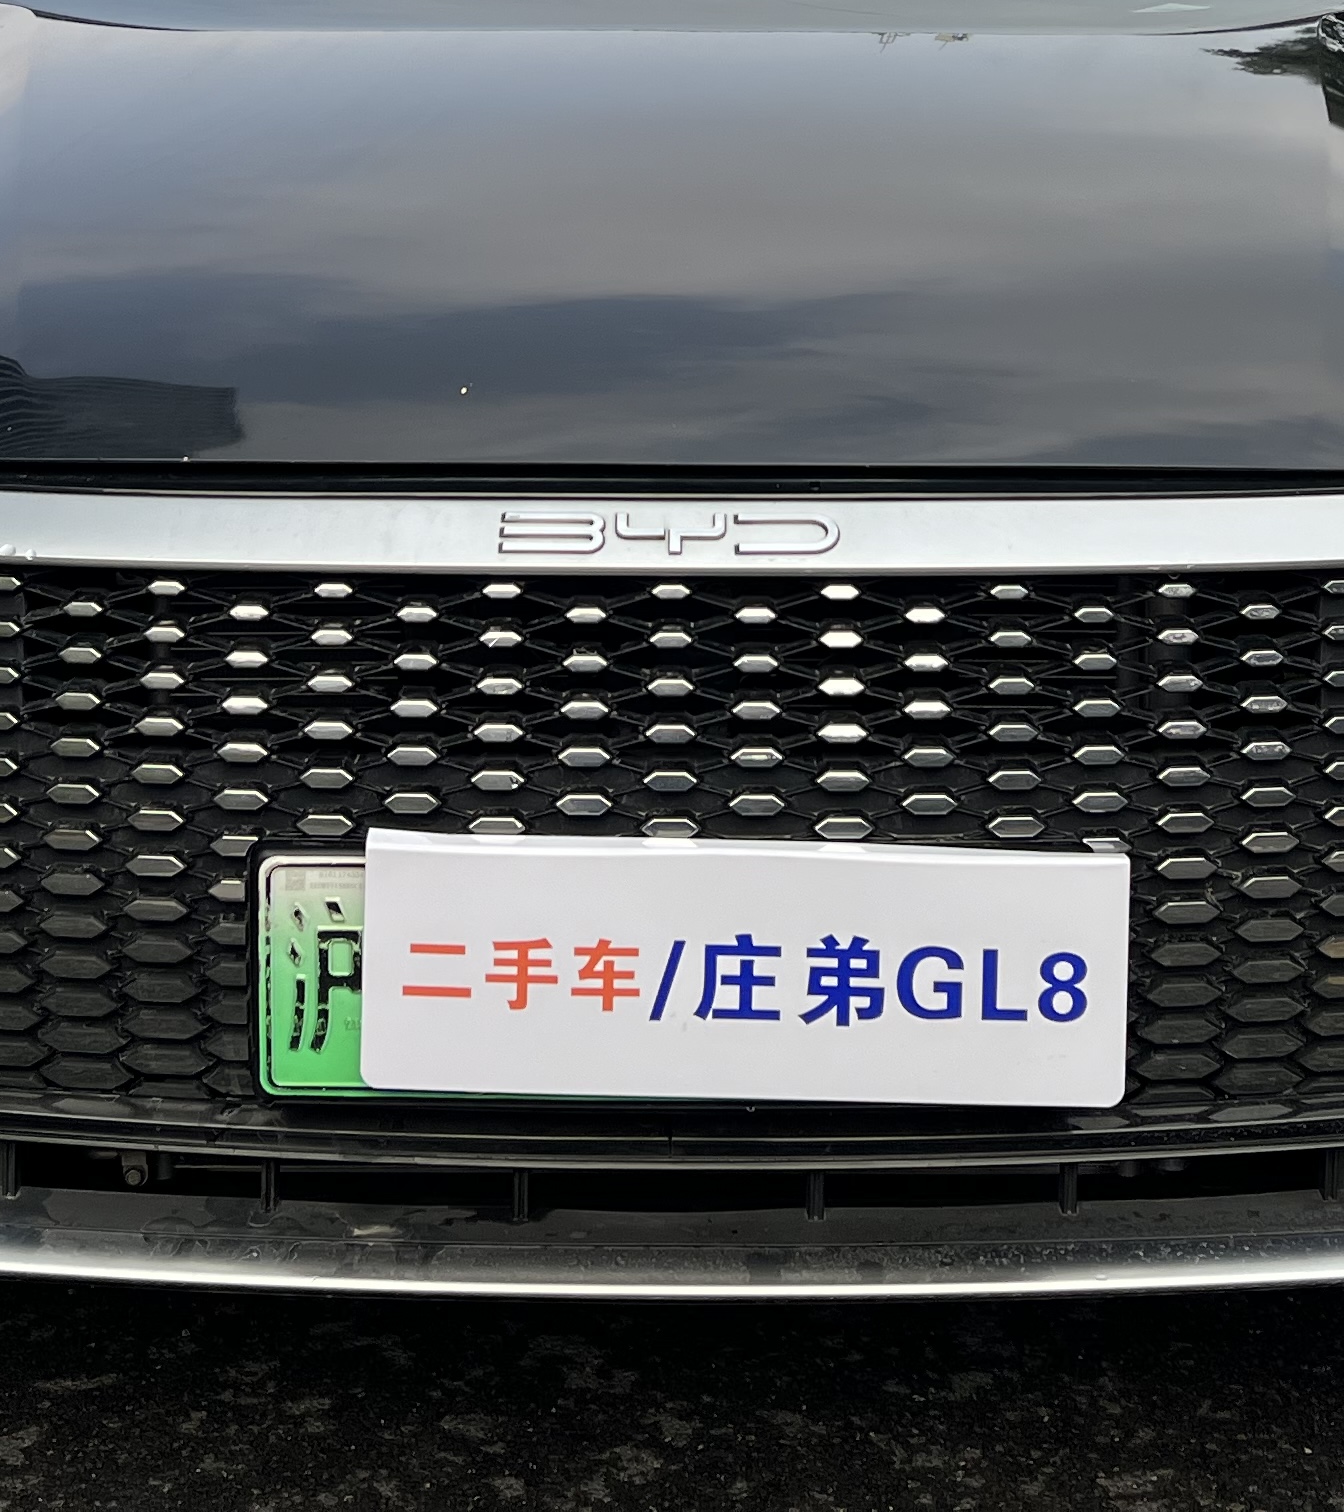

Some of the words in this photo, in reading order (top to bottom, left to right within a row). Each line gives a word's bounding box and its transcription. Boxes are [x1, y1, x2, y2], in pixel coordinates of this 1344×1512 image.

[498, 511, 840, 555] BYD
[402, 935, 1090, 1026] 二手车/庄弟GL8
